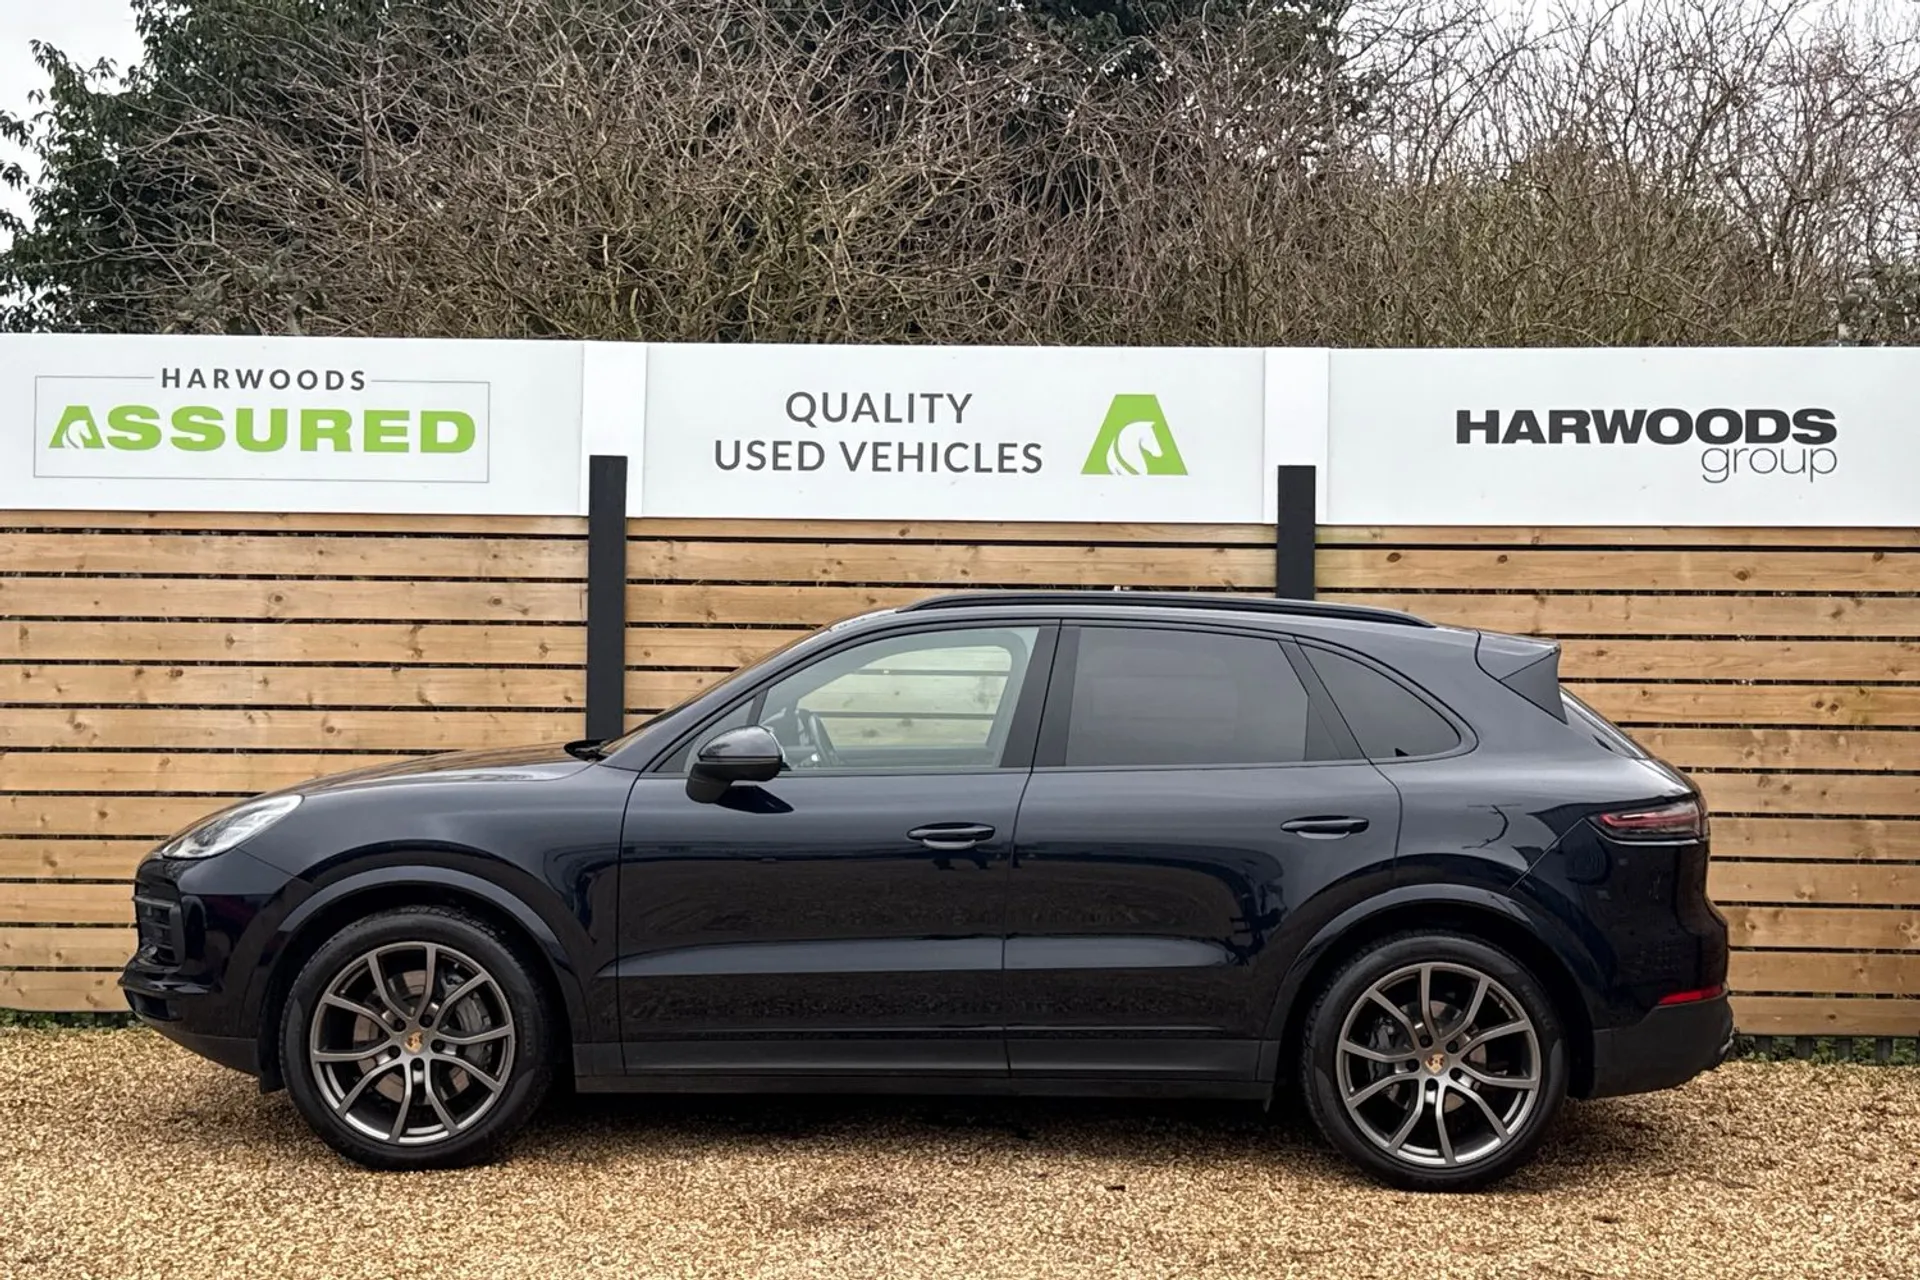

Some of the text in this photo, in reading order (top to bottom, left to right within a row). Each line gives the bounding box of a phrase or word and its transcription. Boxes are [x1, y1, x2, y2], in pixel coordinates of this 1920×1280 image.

[161, 367, 365, 391] HARWOODS
[785, 391, 973, 429] QUALITY
[1456, 407, 1838, 446] HARWOODS
[49, 405, 475, 453] ASSURED
[715, 439, 1043, 474] USED VEHICLES
[1701, 447, 1838, 484] group
